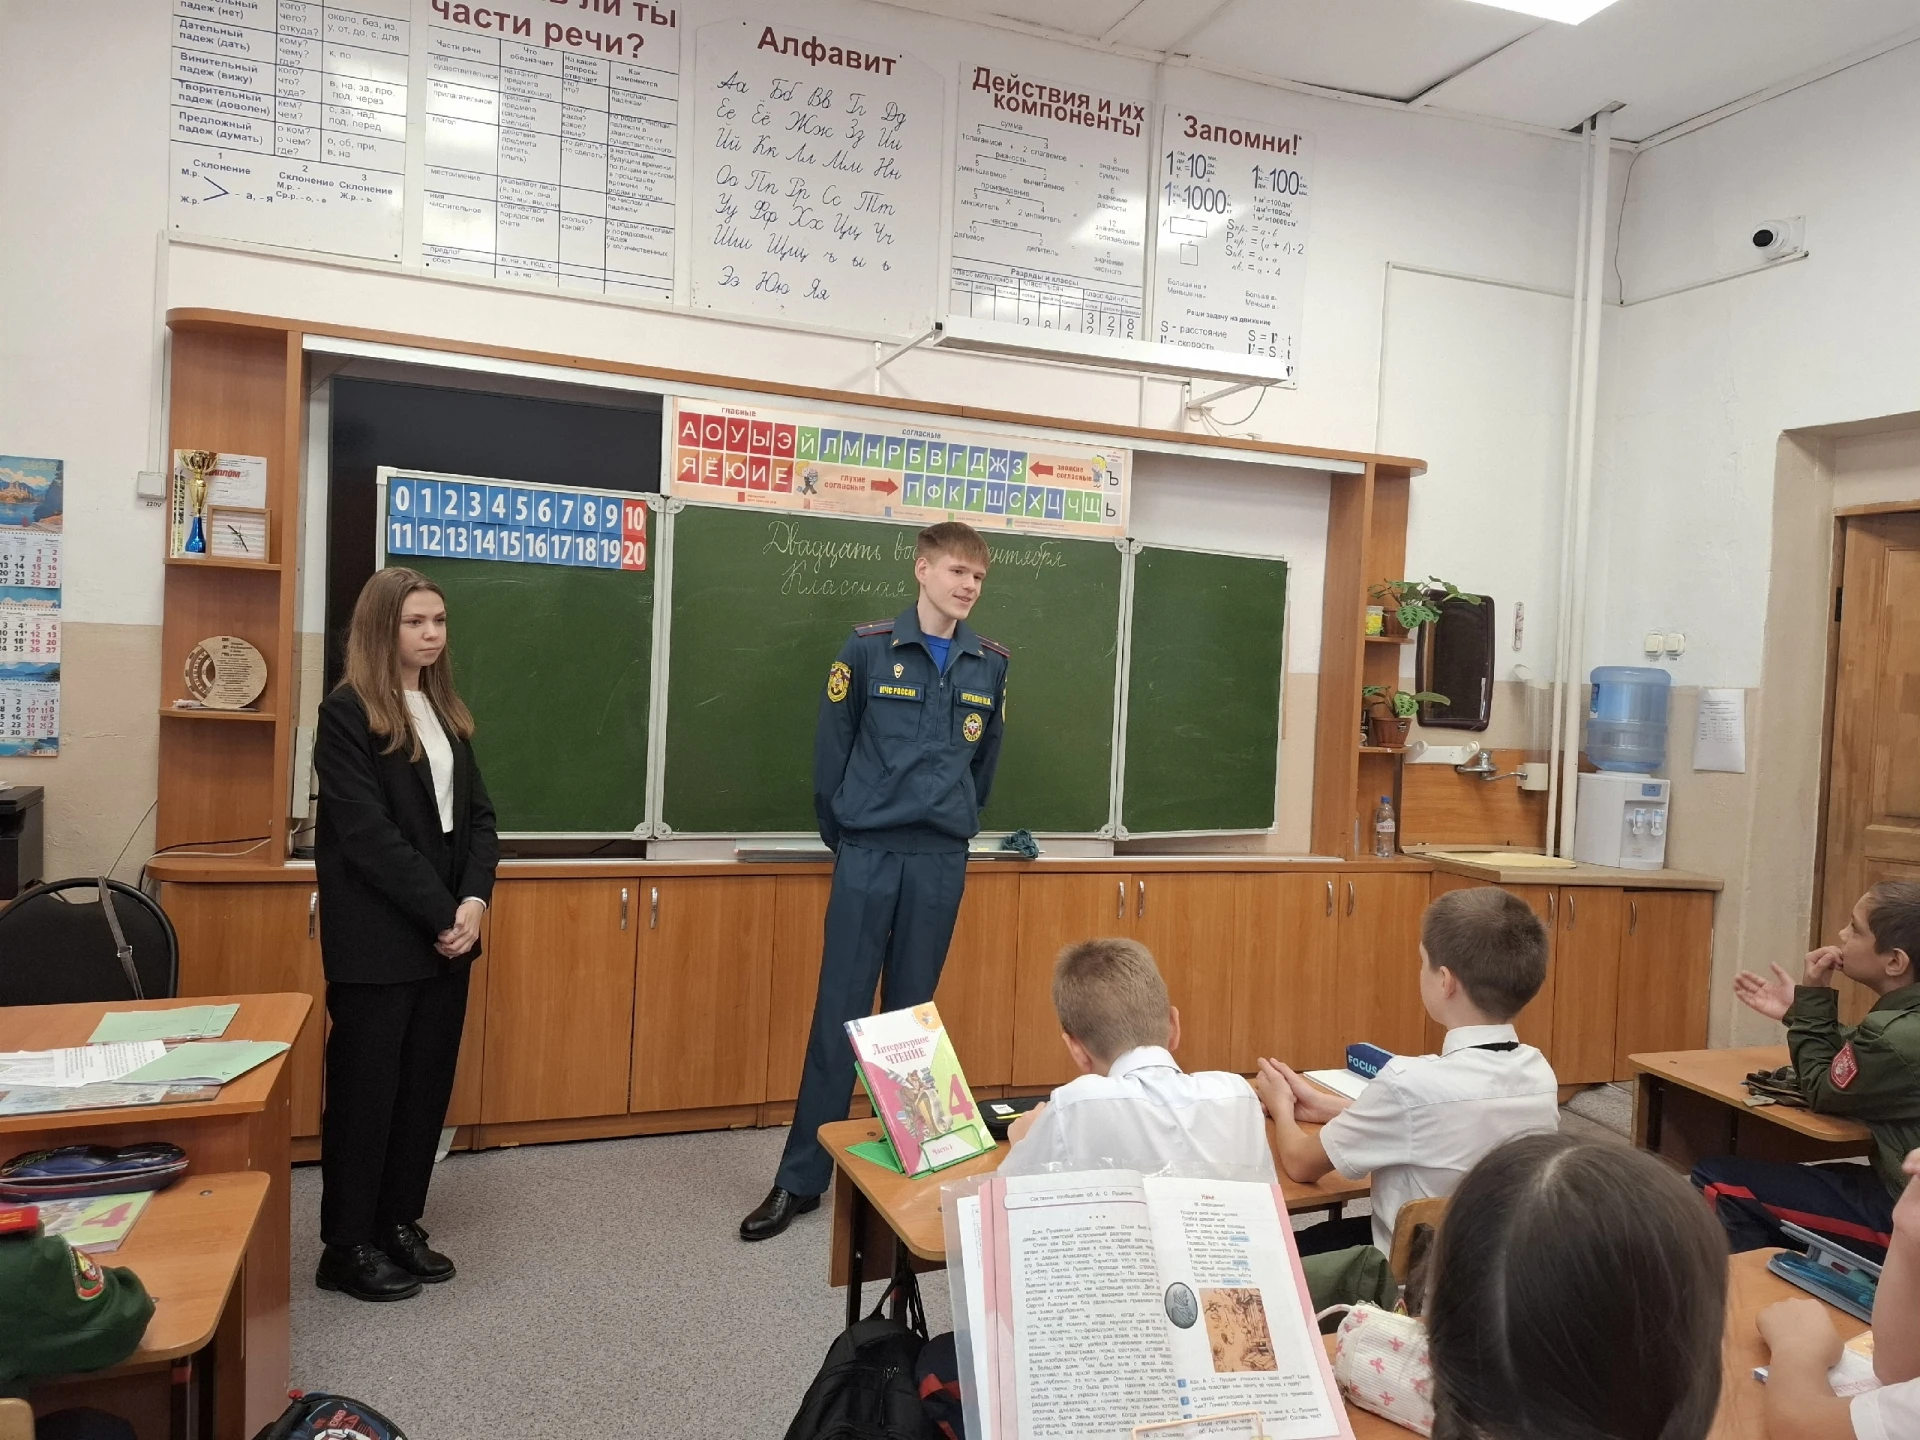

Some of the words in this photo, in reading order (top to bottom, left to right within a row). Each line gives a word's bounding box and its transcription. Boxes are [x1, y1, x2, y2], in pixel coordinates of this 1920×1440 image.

[180, 1, 215, 13] падеж
[218, 6, 244, 20] (нет)
[280, 2, 306, 12] кого?
[632, 1, 676, 28] ты
[280, 13, 307, 24] чего?
[180, 20, 243, 38] Дательный
[280, 24, 319, 36] откуда?
[432, 0, 531, 37] части
[544, 20, 645, 59] речи?
[180, 32, 214, 44] падеж
[218, 38, 250, 52] (дать)
[280, 36, 308, 48] кому?
[758, 26, 896, 75] Алфавит
[280, 47, 310, 58] чему?
[180, 52, 258, 73] Винительный
[180, 65, 214, 77] падеж
[218, 71, 252, 84] (вижу)
[278, 77, 300, 86] что?
[179, 80, 262, 102] Творительный
[278, 88, 306, 97] куда?
[356, 95, 384, 105] через
[972, 66, 1090, 110] Действия
[1098, 98, 1111, 114] и
[1119, 102, 1145, 122] их
[179, 94, 213, 105] падеж
[216, 99, 270, 116] (доволен)
[717, 70, 750, 94] Аа
[770, 78, 803, 101] Бб
[808, 87, 834, 109] Вв
[846, 93, 866, 116] Гг
[881, 102, 906, 131] Дд
[179, 112, 252, 130] Предложный
[278, 111, 303, 120] чем?
[716, 98, 736, 120] Ее
[752, 100, 771, 126] Ёё
[786, 110, 834, 138] Жж
[846, 118, 866, 149] Зз
[878, 127, 903, 151] Ии
[994, 93, 1140, 138] компоненты
[179, 124, 213, 136] падеж
[216, 129, 263, 145] (думать)
[352, 121, 381, 132] перед
[1000, 120, 1023, 131] сумма
[1183, 115, 1298, 156] Запомни!
[277, 148, 299, 157] где?
[193, 159, 251, 175] Склонение
[279, 172, 334, 187] Склонение
[339, 181, 393, 196] Склонение
[716, 164, 739, 187] Оо
[744, 170, 778, 195] Пп
[785, 177, 810, 207] Рр
[822, 184, 842, 207] Сс
[854, 190, 896, 216] Тт
[718, 266, 741, 287] Ээ
[755, 271, 791, 295] Юю
[803, 277, 830, 300] Яя
[1086, 313, 1094, 324] 3
[1107, 316, 1115, 328] 2
[1127, 318, 1135, 330] 8
[1180, 325, 1227, 338] расстояние
[722, 406, 756, 417] гласные
[682, 421, 698, 439] А
[705, 424, 722, 441] О
[731, 426, 745, 444] У
[753, 430, 770, 447] Ы
[777, 432, 792, 449] Э
[902, 428, 941, 439] согласные
[682, 457, 696, 474] Я
[706, 457, 718, 478] Ё
[726, 462, 746, 480] Ю
[752, 465, 766, 482] И
[776, 468, 789, 484] Е
[1106, 471, 1119, 486] Ъ
[824, 481, 866, 491] согласные
[395, 486, 410, 511] 0
[421, 488, 431, 513] 1
[445, 490, 458, 516] 2
[469, 492, 481, 517] 3
[492, 494, 506, 519] 4
[516, 496, 527, 521] 5
[538, 498, 551, 522] 6
[561, 500, 574, 524] 7
[584, 502, 596, 526] 8
[606, 504, 618, 528] 9
[625, 506, 644, 531] 10
[1106, 502, 1116, 517] Ь
[392, 522, 412, 549] 11
[419, 525, 441, 550] 12
[447, 527, 468, 552] 13
[474, 529, 495, 554] 14
[500, 531, 520, 556] 15
[526, 533, 546, 558] 16
[551, 535, 571, 560] 17
[576, 537, 596, 562] 18
[600, 539, 620, 564] 19
[624, 541, 644, 565] 20
[763, 520, 882, 574] Двадцать
[872, 1035, 930, 1056] Литературное
[885, 1048, 926, 1065] ЧТЕНИЕ
[1348, 1054, 1378, 1075] FOCUS
[949, 1074, 974, 1121] 4
[932, 1145, 948, 1156] Часть
[82, 1202, 134, 1228] 4
